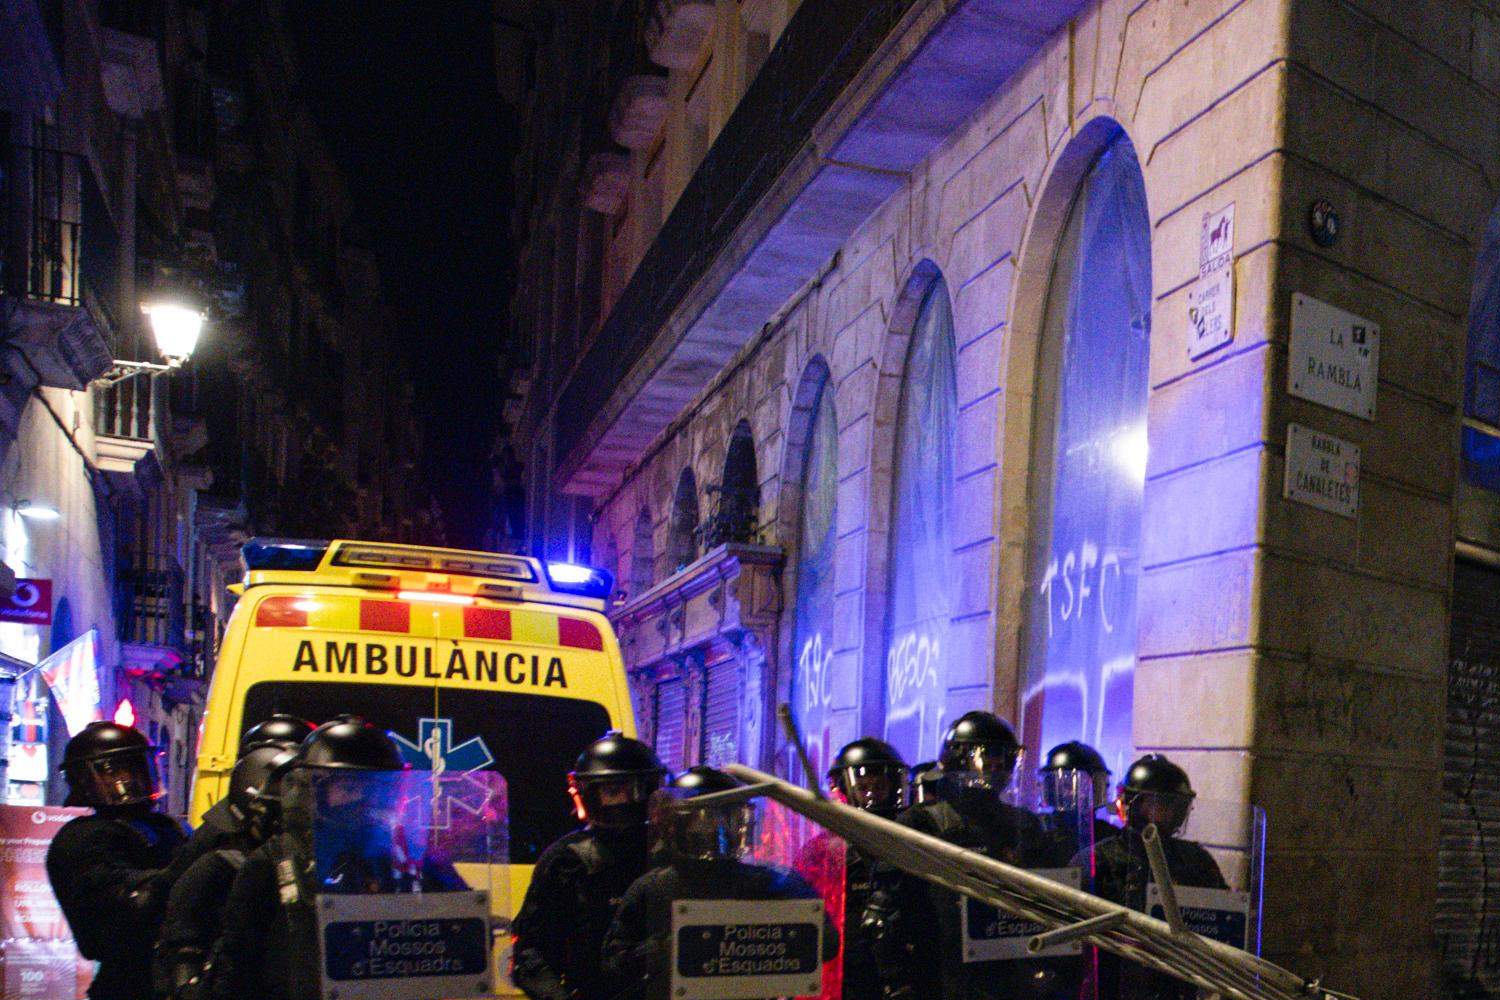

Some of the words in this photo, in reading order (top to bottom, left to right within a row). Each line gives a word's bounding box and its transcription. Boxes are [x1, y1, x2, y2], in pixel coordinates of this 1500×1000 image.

[1330, 327, 1344, 349] LA
[1307, 356, 1362, 393] RAMBLA
[292, 640, 568, 688] AMBULÀNCIA
[373, 921, 441, 939] Policia
[724, 925, 782, 941] Policia
[368, 939, 447, 957] Mossos
[719, 941, 787, 957] Mossos
[350, 956, 464, 977] d'Esquadra
[702, 957, 801, 975] d'Esquadra
